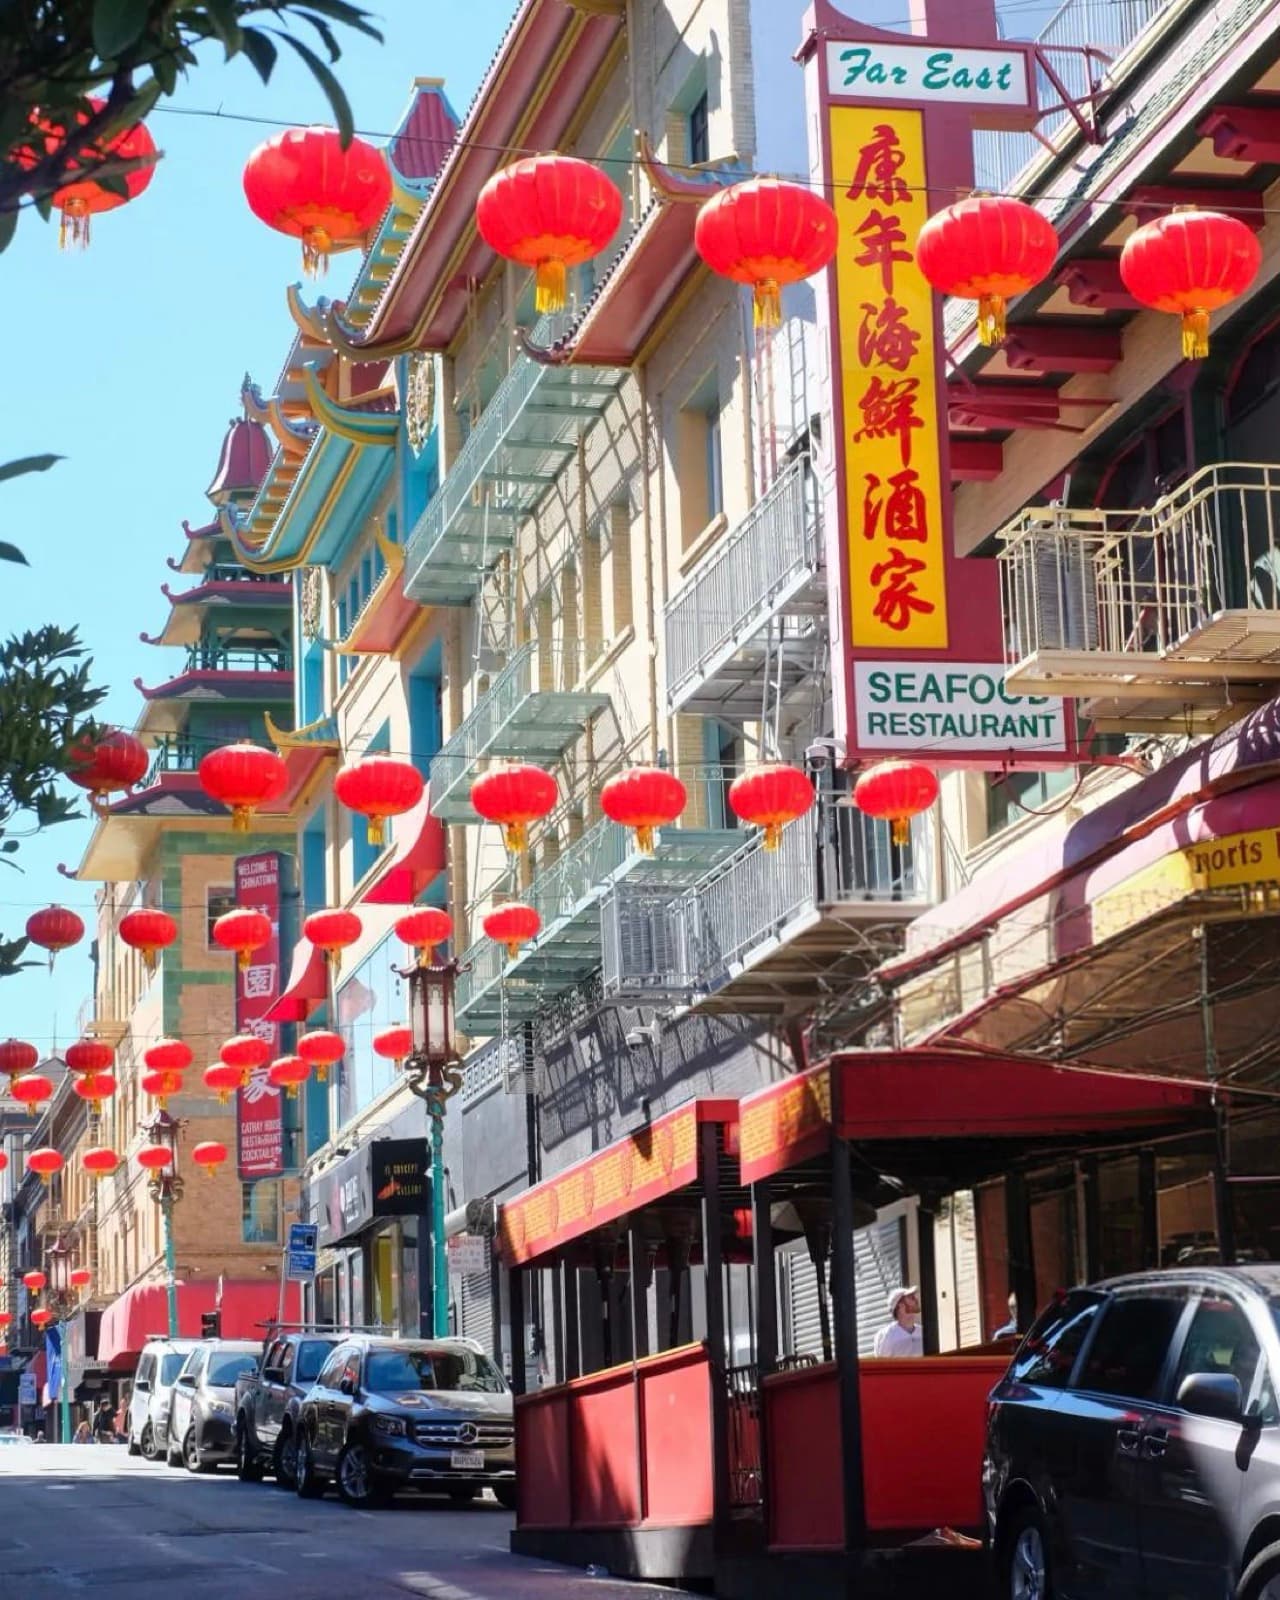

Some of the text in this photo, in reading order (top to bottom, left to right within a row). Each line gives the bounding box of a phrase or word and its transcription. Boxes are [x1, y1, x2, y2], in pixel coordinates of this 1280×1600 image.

[838, 47, 1012, 92] Far East
[846, 124, 934, 632] 康年海鮮酒家
[868, 671, 1049, 705] SEAFO
[867, 712, 1056, 738] RESTAURANT
[238, 858, 279, 876] WELCOME TO
[241, 873, 278, 890] CHINATOWN
[241, 1121, 263, 1134] CATHAY
[241, 1132, 281, 1147] RESTAURANT
